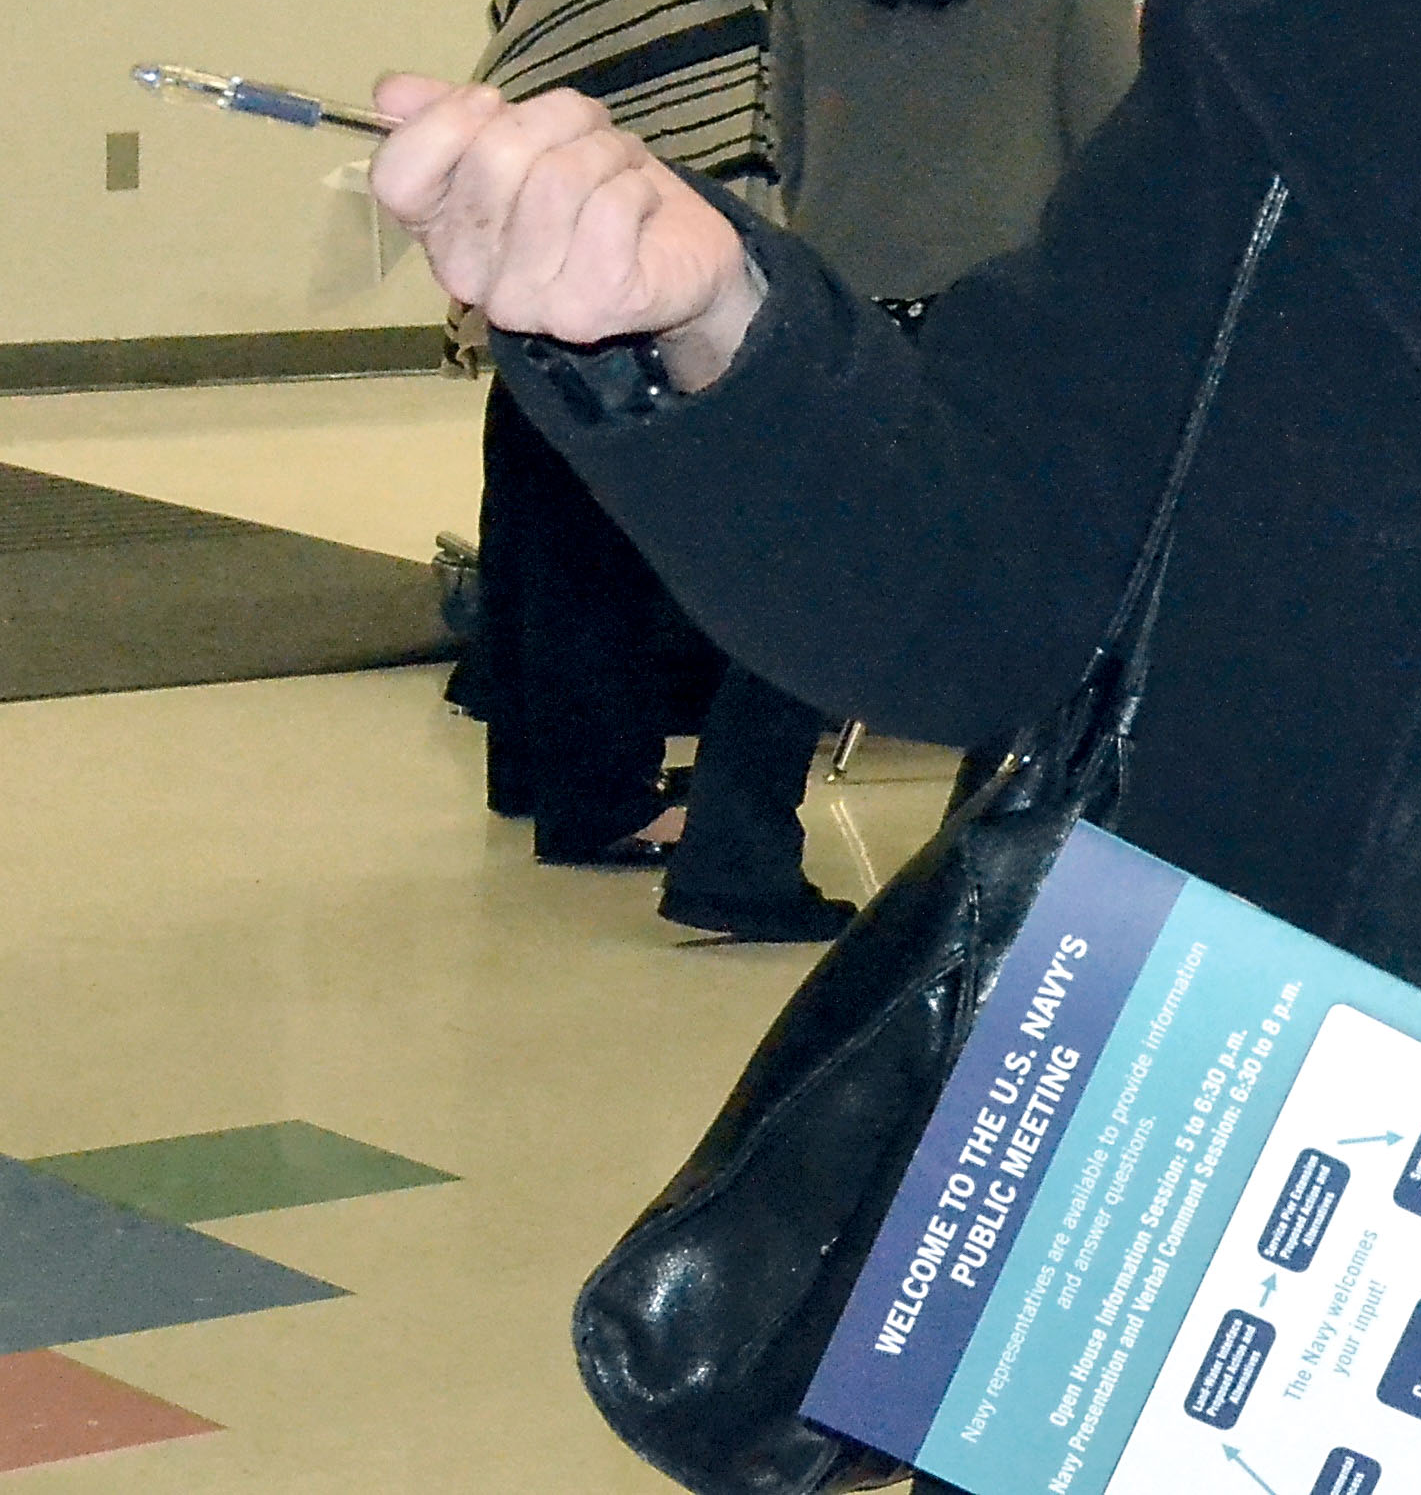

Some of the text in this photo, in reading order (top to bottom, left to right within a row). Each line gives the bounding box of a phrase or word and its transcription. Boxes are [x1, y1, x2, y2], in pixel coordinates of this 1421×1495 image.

[874, 933, 1088, 1355] WELCOME TO THE U.S. NAVY'S
[950, 1045, 1081, 1288] PUBLIC MEETING
[960, 941, 1209, 1443] Navy representatives are available to provide information
[1049, 1030, 1248, 1427] Open House Information Session: 5 to 6:30 p.m.
[1057, 1116, 1157, 1310] and answer questions.
[1263, 1221, 1288, 1258] Service
[1280, 1200, 1298, 1222] Pier
[1279, 1164, 1331, 1260] Proposed Action and
[1302, 1191, 1335, 1247] Alternatives
[1047, 981, 1303, 1495] Navy Presentation and Verbal Comment Session: 6:30 to 8 p.m.
[1283, 1229, 1378, 1400] The Navy welcomes
[1333, 1279, 1387, 1378] your input!
[1205, 1324, 1257, 1418] Proposed Action and
